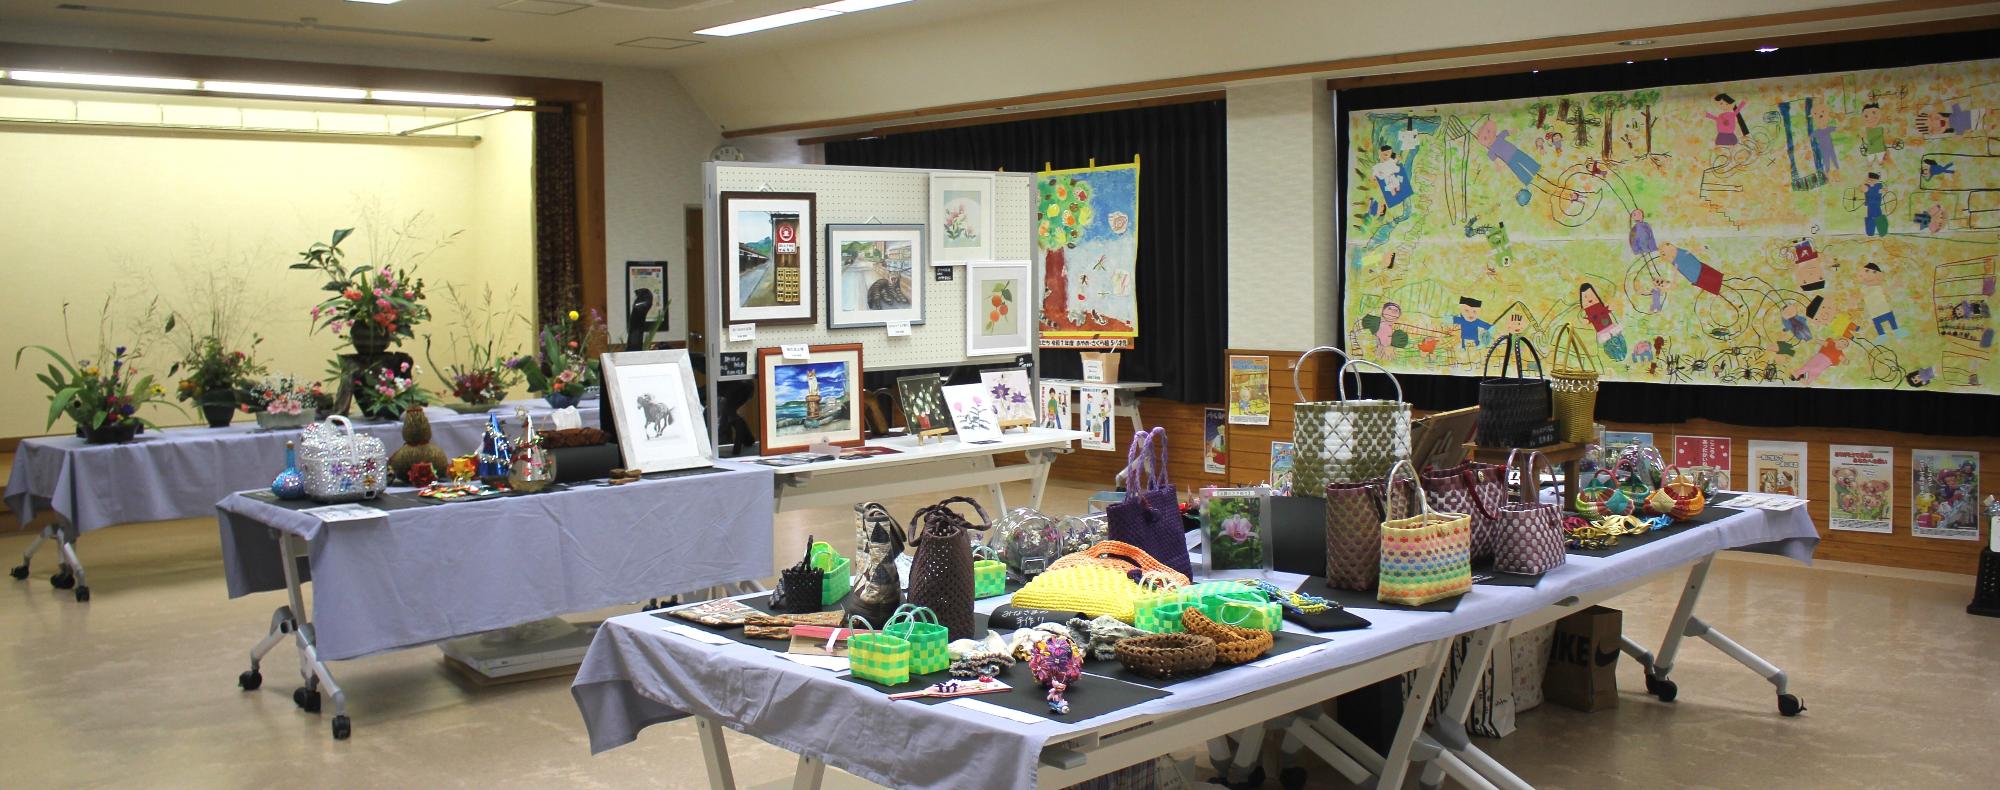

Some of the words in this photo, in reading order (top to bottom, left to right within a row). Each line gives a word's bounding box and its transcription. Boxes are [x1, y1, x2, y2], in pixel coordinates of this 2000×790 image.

[1016, 616, 1044, 627] 手作り
[1551, 631, 1589, 667] IKE
